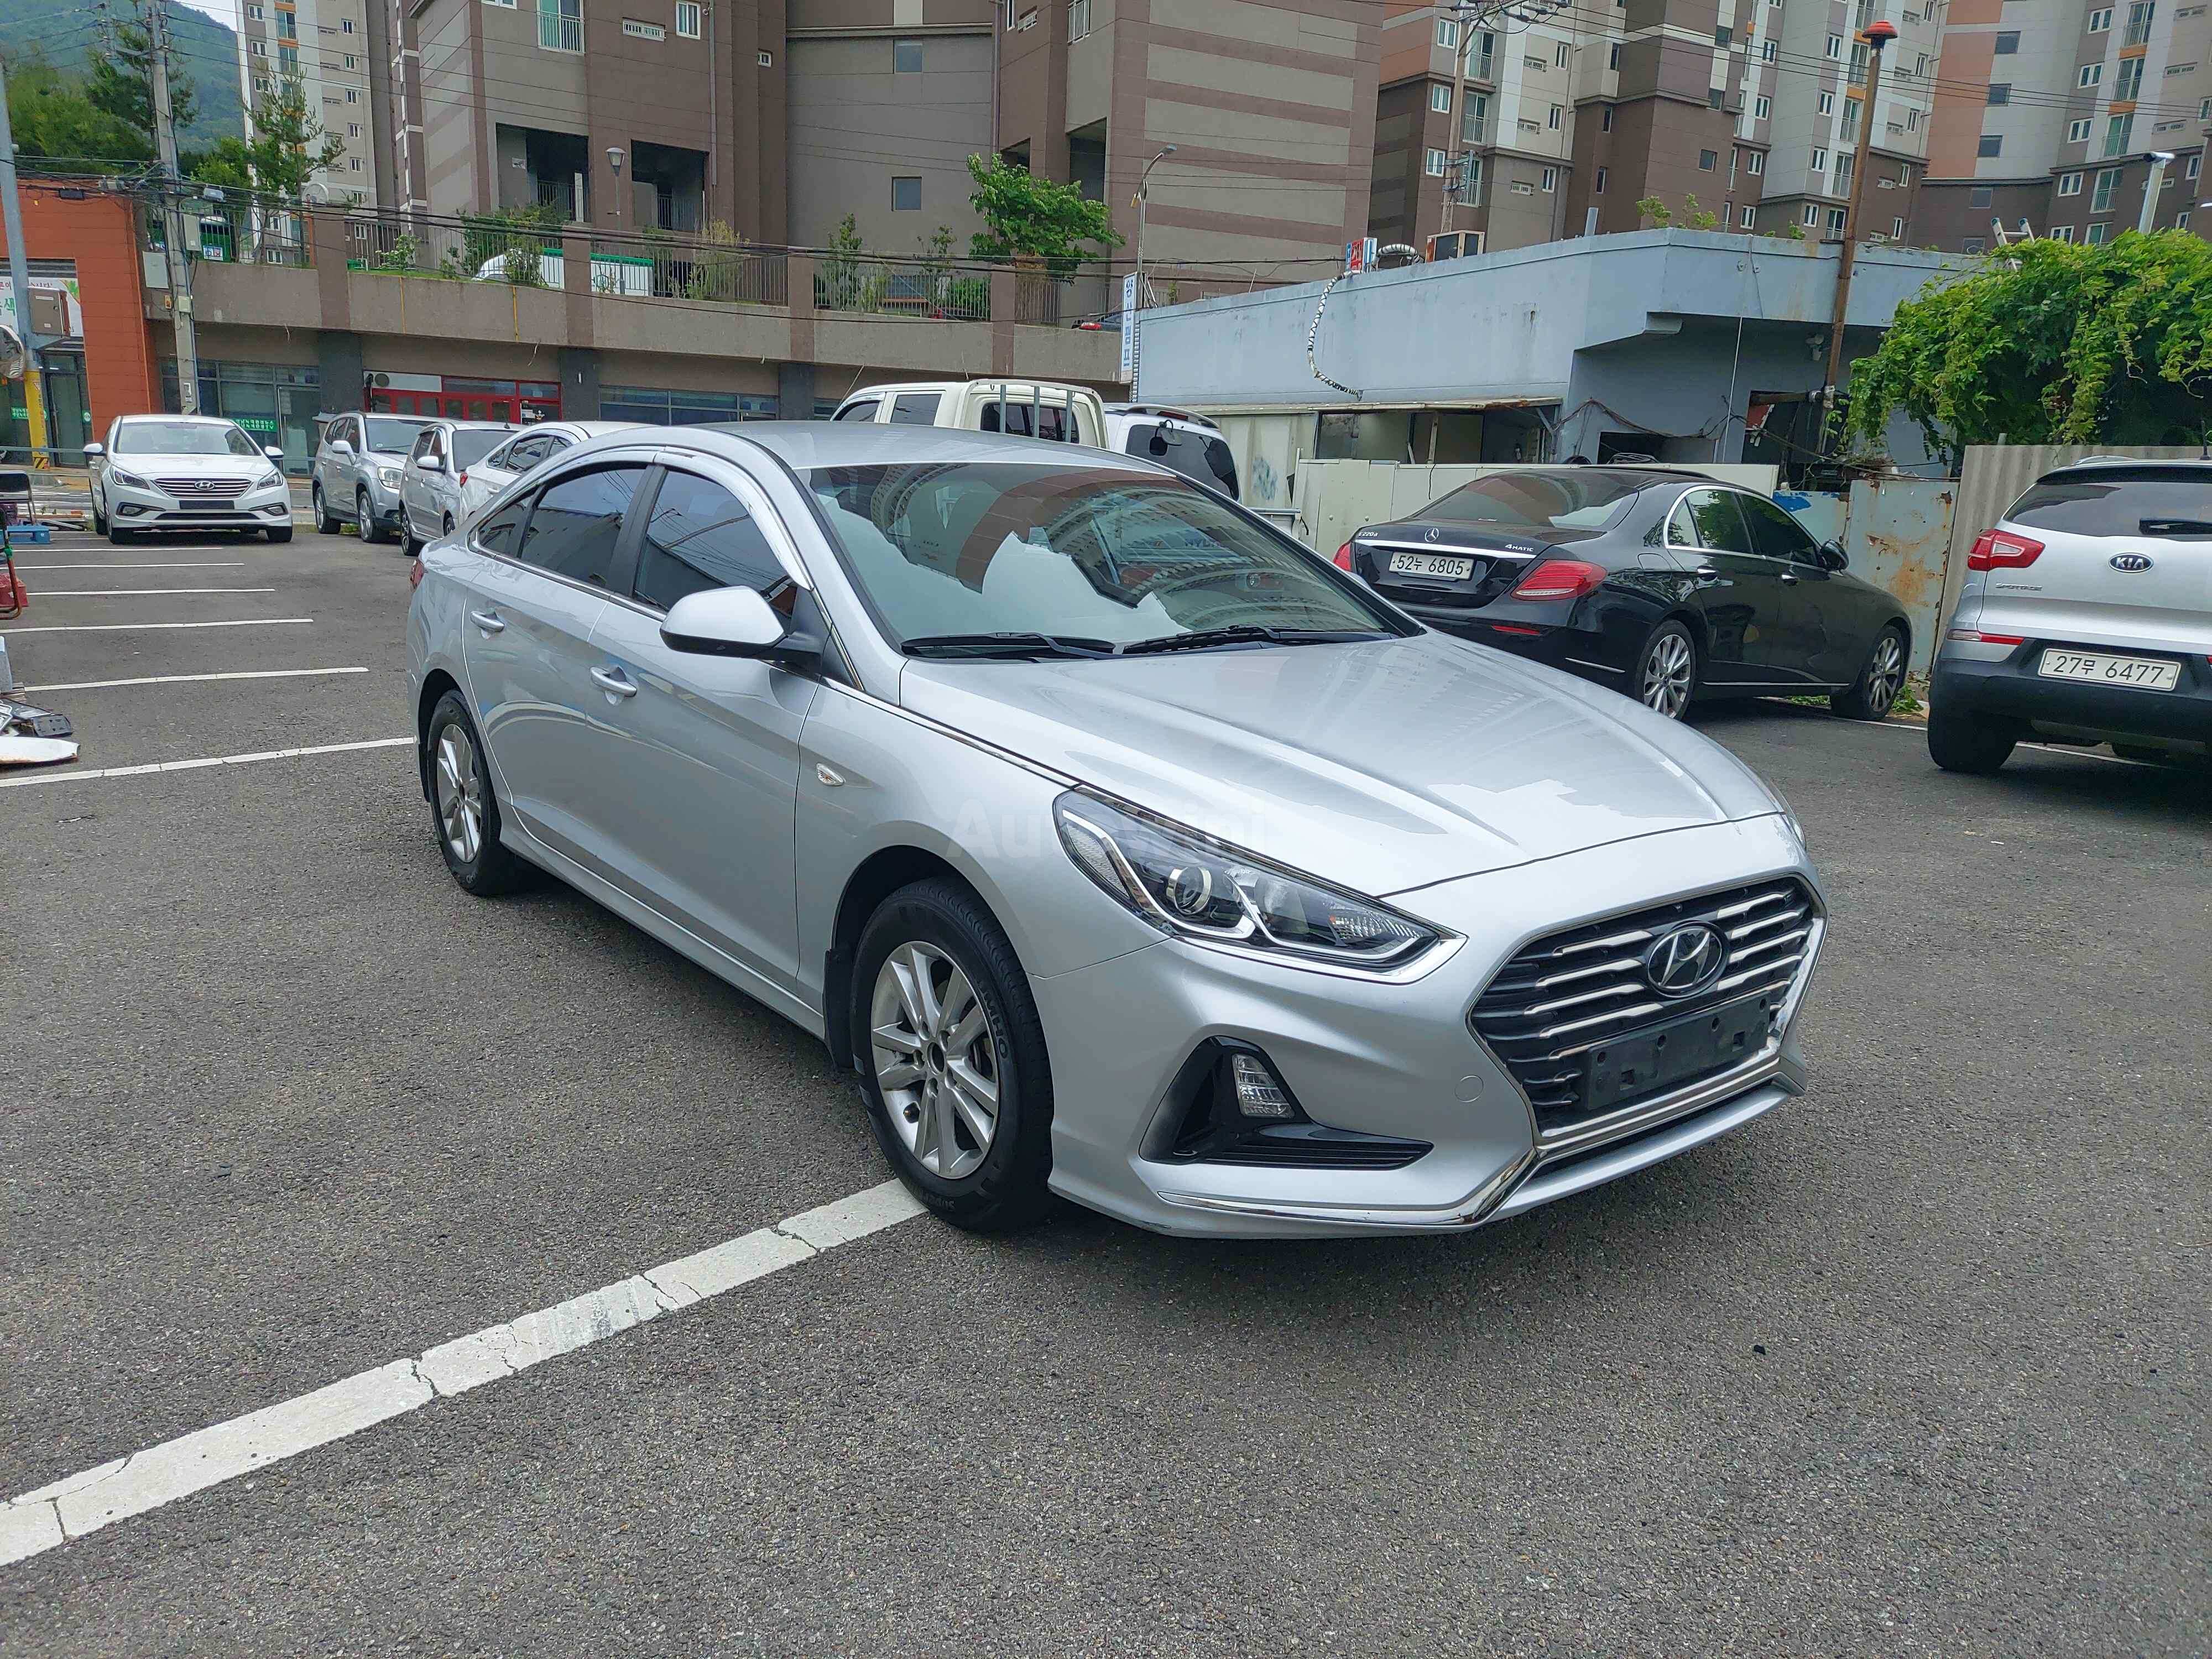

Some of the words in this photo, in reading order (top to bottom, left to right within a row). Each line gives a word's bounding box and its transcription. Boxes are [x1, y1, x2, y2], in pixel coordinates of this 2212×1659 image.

[1505, 544, 1534, 552] 4MATIC
[1396, 555, 1422, 571] 52누
[1428, 557, 1465, 576] 6805
[2116, 556, 2145, 569] KIA
[2053, 655, 2096, 675] 27무
[2105, 661, 2164, 684] 6477
